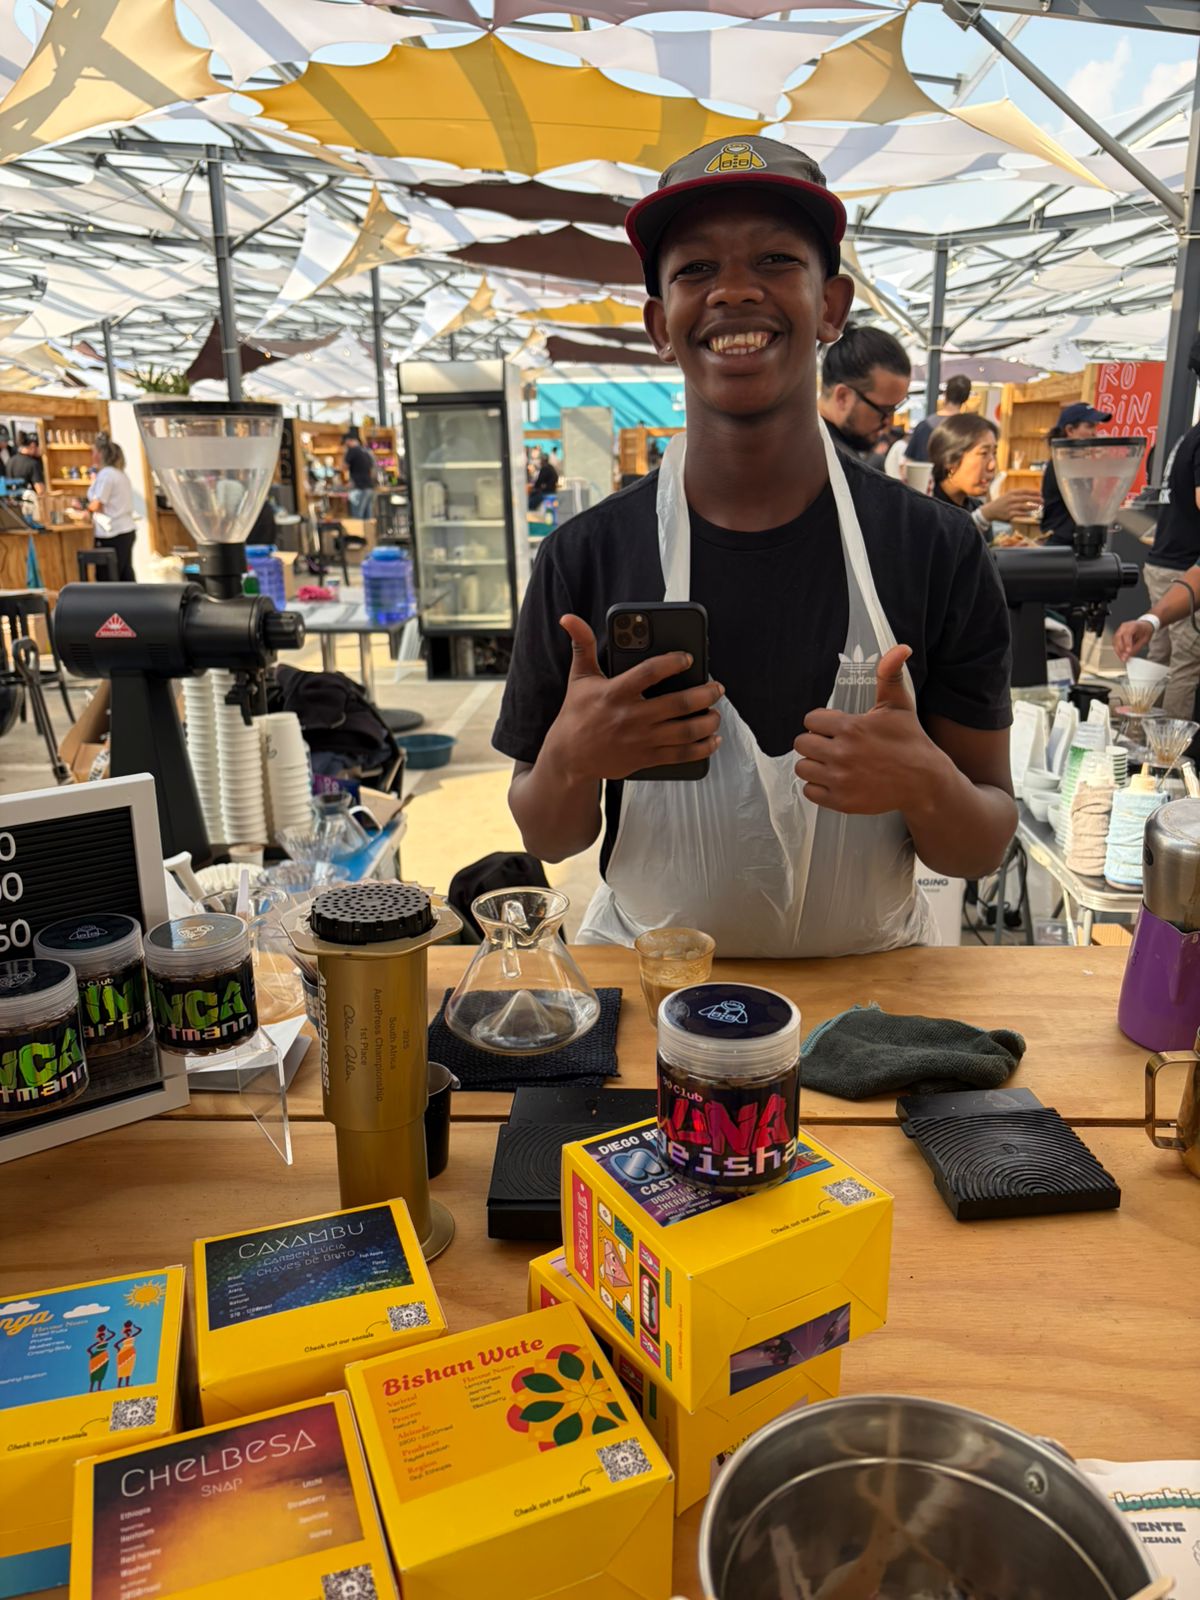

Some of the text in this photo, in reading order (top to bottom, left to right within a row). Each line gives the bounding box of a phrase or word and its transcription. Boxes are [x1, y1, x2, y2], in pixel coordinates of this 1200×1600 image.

[838, 672, 878, 685] adidas
[389, 1017, 397, 1041] South
[360, 1027, 369, 1066] 1st Place
[373, 988, 385, 1103] AeroPress Championship
[673, 1085, 704, 1103] Club
[598, 1136, 640, 1155] DIEGO
[239, 1222, 364, 1259] CAXAMBU
[771, 1225, 790, 1235] Check
[304, 1344, 326, 1353] Check
[352, 1332, 374, 1341] socials
[383, 1338, 545, 1396] Bishan Wate
[8, 1431, 88, 1452] Check out our socials
[201, 1477, 243, 1498] SNAP
[514, 1486, 591, 1517] Check out our socials
